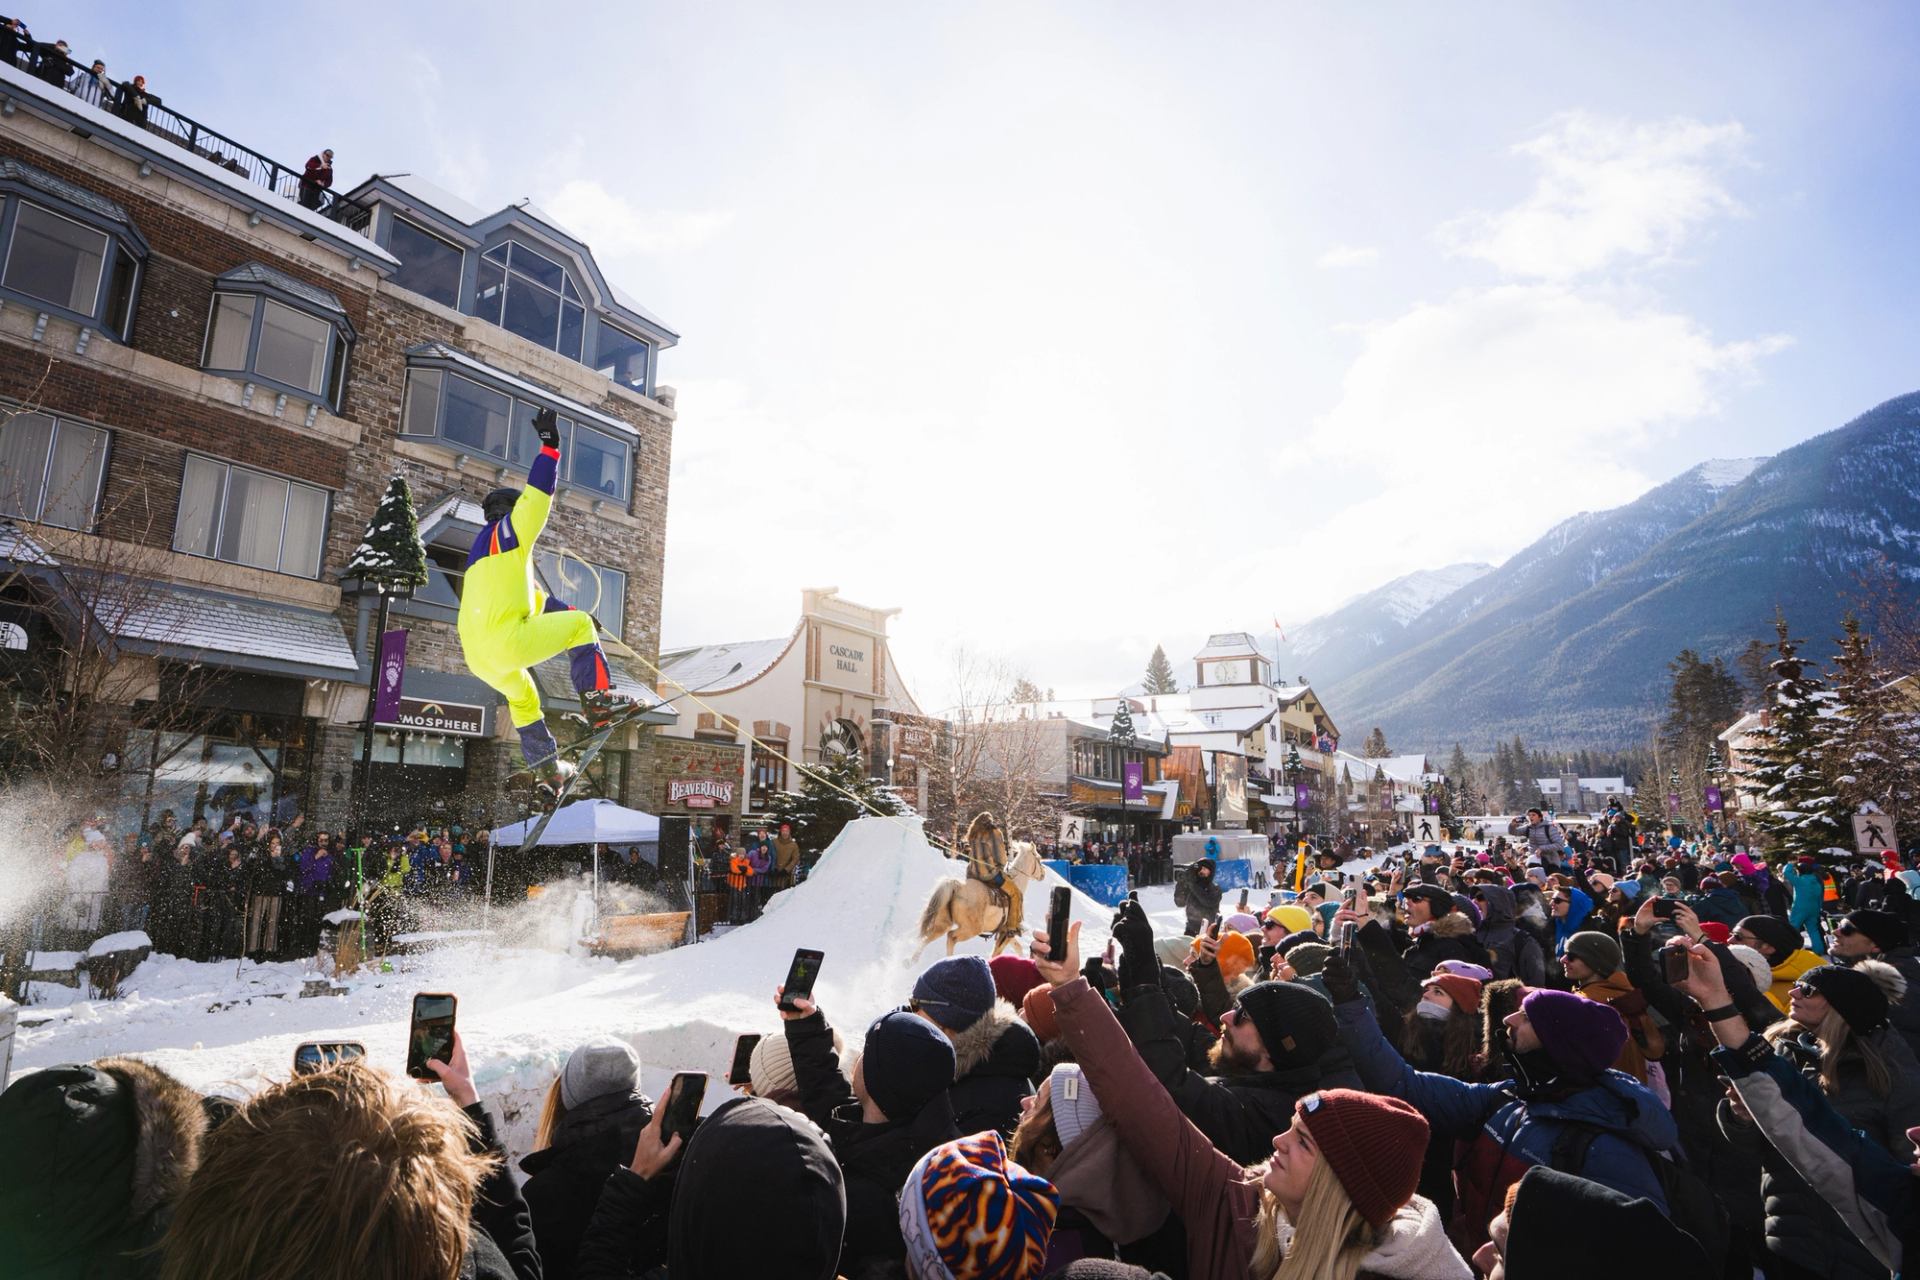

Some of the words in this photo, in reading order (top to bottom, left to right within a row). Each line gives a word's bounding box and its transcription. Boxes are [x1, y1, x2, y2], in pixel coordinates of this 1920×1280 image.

[829, 644, 864, 662] CASCADE
[836, 659, 857, 673] HALL
[397, 714, 478, 731] MOSPHERE
